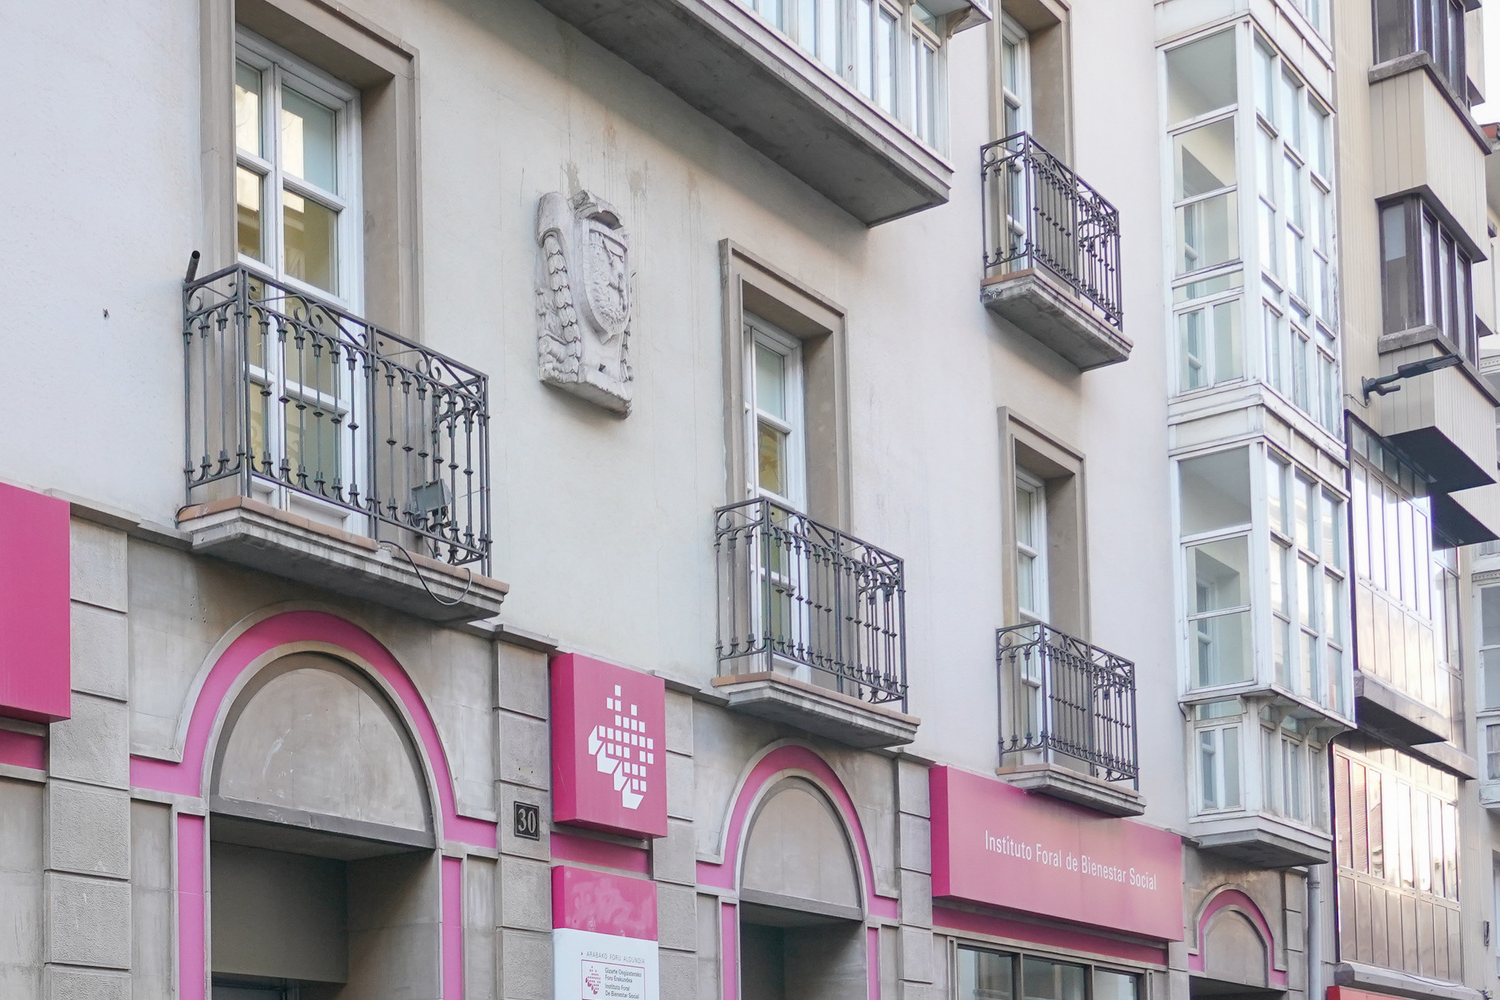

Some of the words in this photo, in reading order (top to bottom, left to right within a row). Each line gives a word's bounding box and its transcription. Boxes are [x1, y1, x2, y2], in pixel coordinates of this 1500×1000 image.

[518, 809, 536, 833] 30
[985, 830, 1032, 860] Instituto
[1036, 843, 1062, 867] Foral
[1066, 852, 1078, 871] de
[1082, 855, 1126, 883] Bienestar
[1129, 868, 1156, 890] Social
[586, 951, 608, 959] ARABAKO
[623, 956, 645, 964] ALDUNDIA
[605, 967, 618, 975] Gizarte
[611, 990, 628, 998] Bienestar
